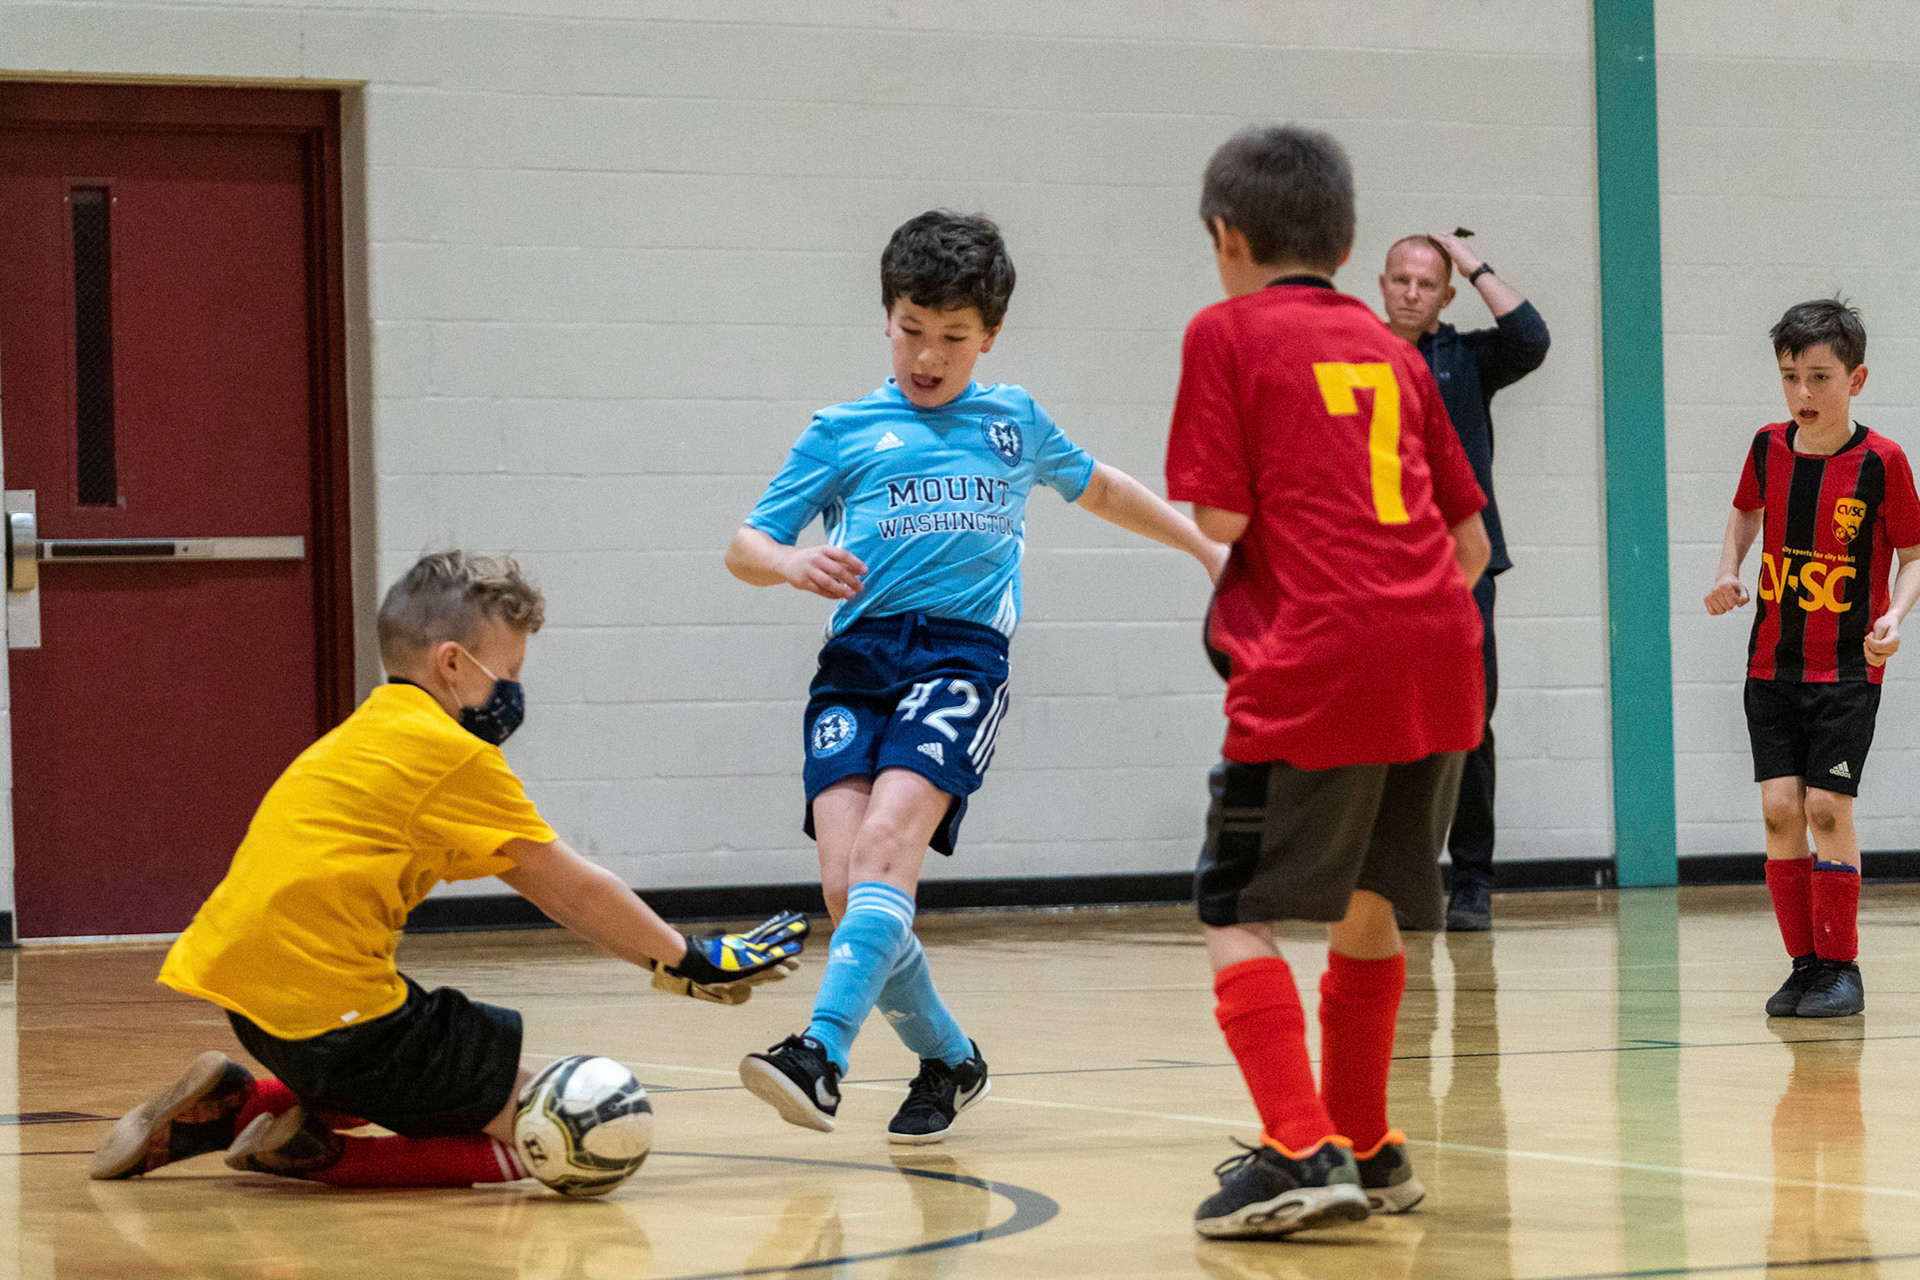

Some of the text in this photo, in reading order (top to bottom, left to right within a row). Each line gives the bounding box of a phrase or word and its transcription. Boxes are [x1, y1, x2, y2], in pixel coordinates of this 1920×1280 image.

[1312, 362, 1410, 524] 7
[887, 476, 1010, 508] MOUNT
[878, 511, 1015, 539] WASHINGTON
[1782, 546, 1792, 555] city
[1792, 549, 1812, 557] sports
[1813, 550, 1824, 559] for
[895, 677, 980, 742] 42
[1828, 768, 1851, 779] adidas
